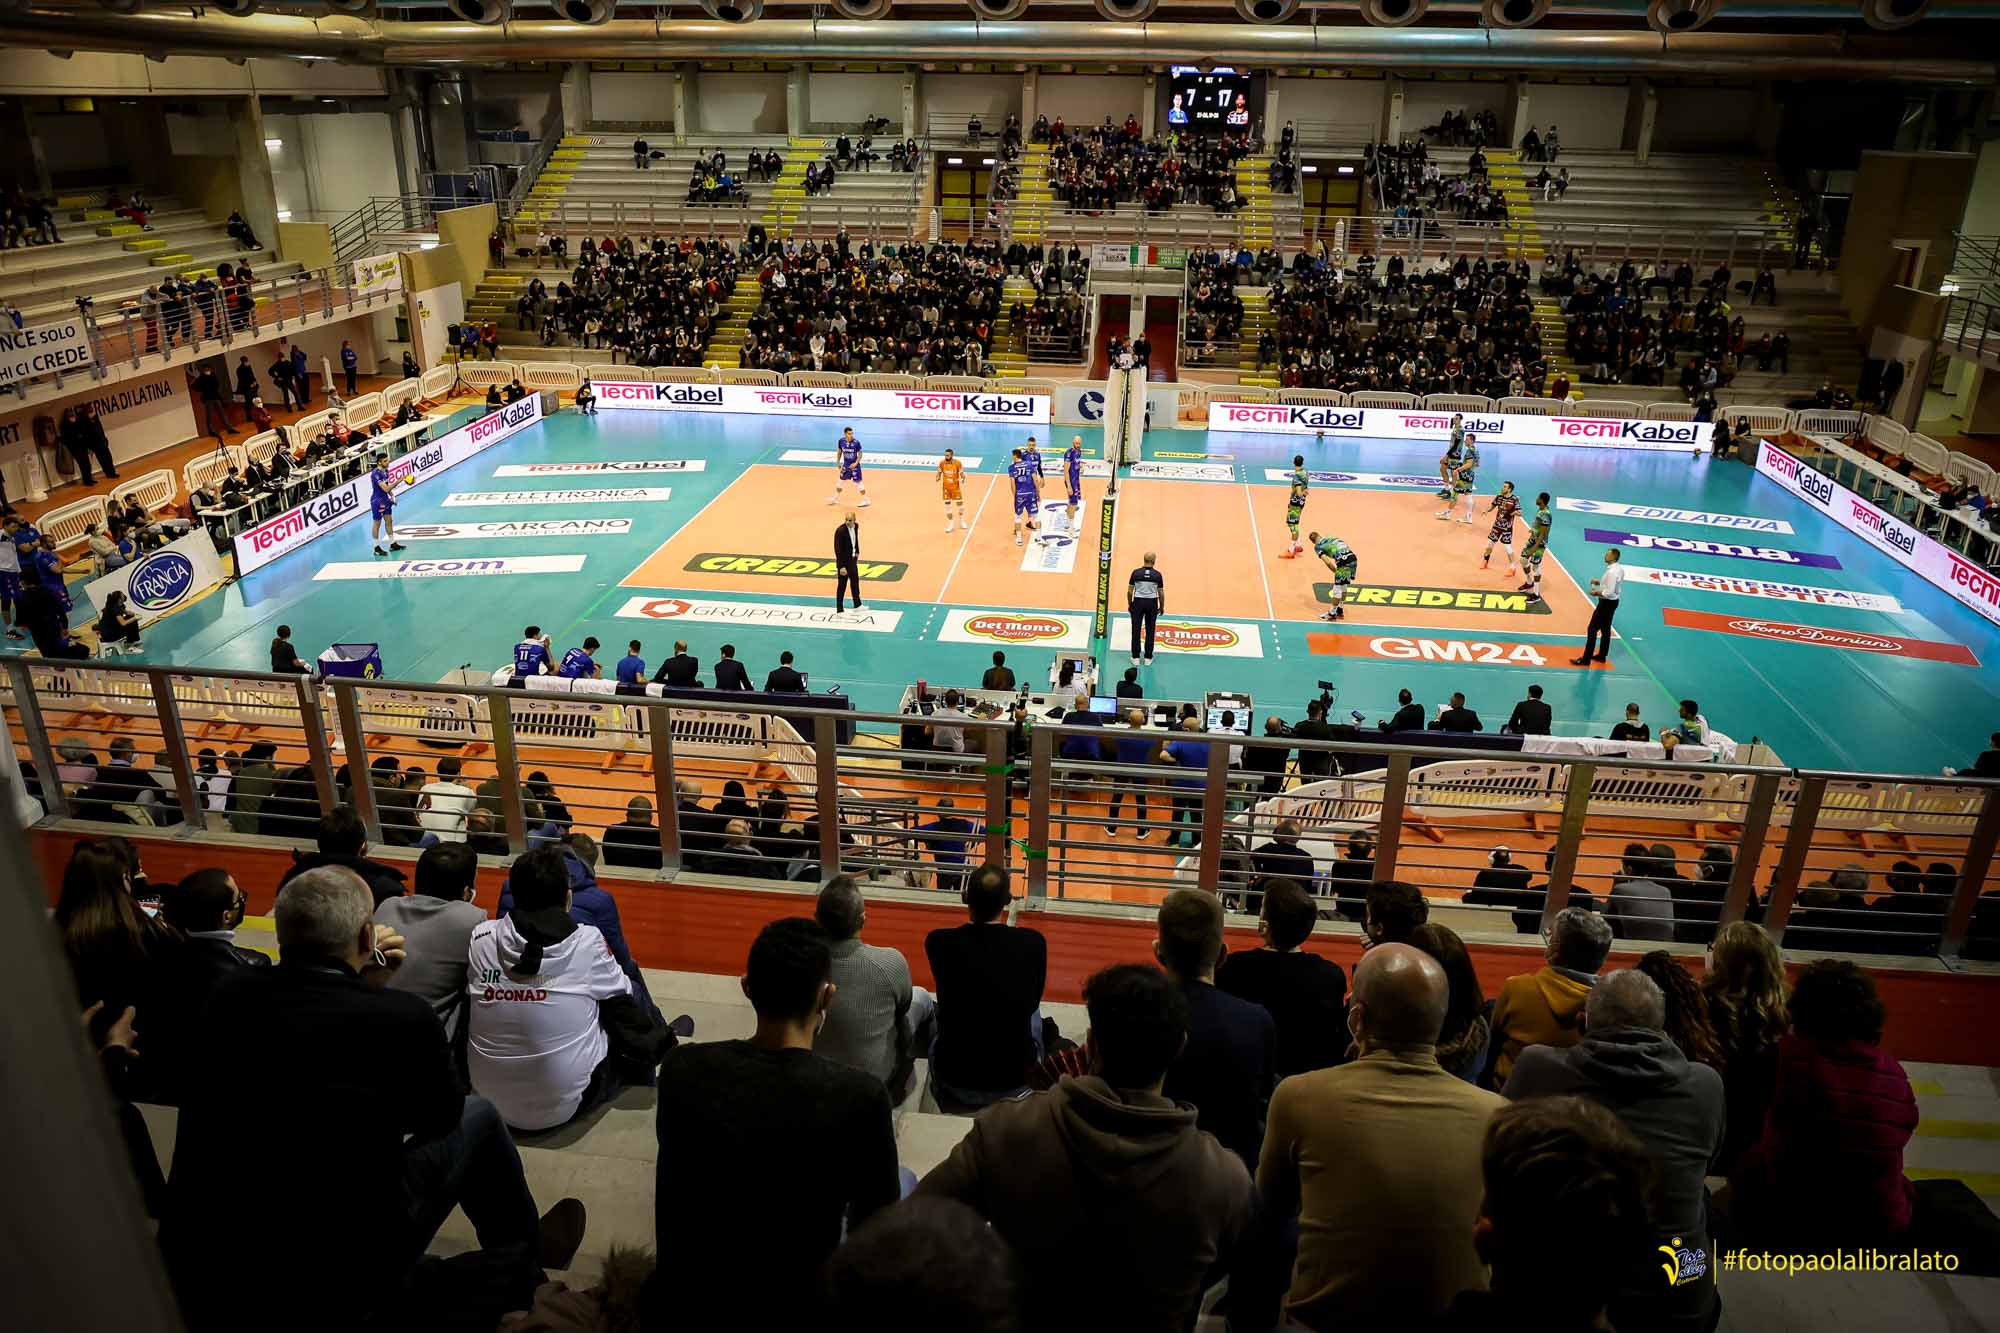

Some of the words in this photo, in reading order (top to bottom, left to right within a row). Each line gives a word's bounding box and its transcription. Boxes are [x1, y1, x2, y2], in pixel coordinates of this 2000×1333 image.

[1187, 88, 1197, 107] 7
[1218, 89, 1232, 107] 17
[40, 326, 76, 344] SOLO
[16, 363, 30, 376] CI
[32, 345, 89, 371] CREDE
[120, 392, 133, 409] DI
[132, 381, 173, 406] LATINA
[592, 383, 723, 405] TecniKabel
[754, 391, 852, 408] TecniKabel
[896, 393, 1035, 416] TecniKabel
[465, 397, 535, 443] TecniKabel
[1220, 404, 1364, 429] TecniKabel
[1552, 419, 1697, 444] TecniKabel
[387, 445, 443, 485] ecniKabel
[1764, 443, 1834, 506] TecniKabel
[243, 484, 359, 553] TecniKabel
[477, 520, 630, 532] CARCANO
[1623, 506, 1779, 531] EDILAPPIA
[1851, 499, 1916, 556] TecniKabel
[398, 560, 505, 573] icom
[135, 561, 190, 600] FRANCIA
[1663, 571, 1849, 599] IDROTERMICA
[1948, 552, 2000, 609] Tecni
[692, 605, 803, 620] GRUPPO
[1005, 622, 1062, 633] Monte
[1155, 630, 1171, 638] el
[1175, 630, 1231, 641] Monte
[1369, 637, 1548, 666] GM24
[481, 968, 501, 983] SIR
[495, 989, 548, 1002] CONAD
